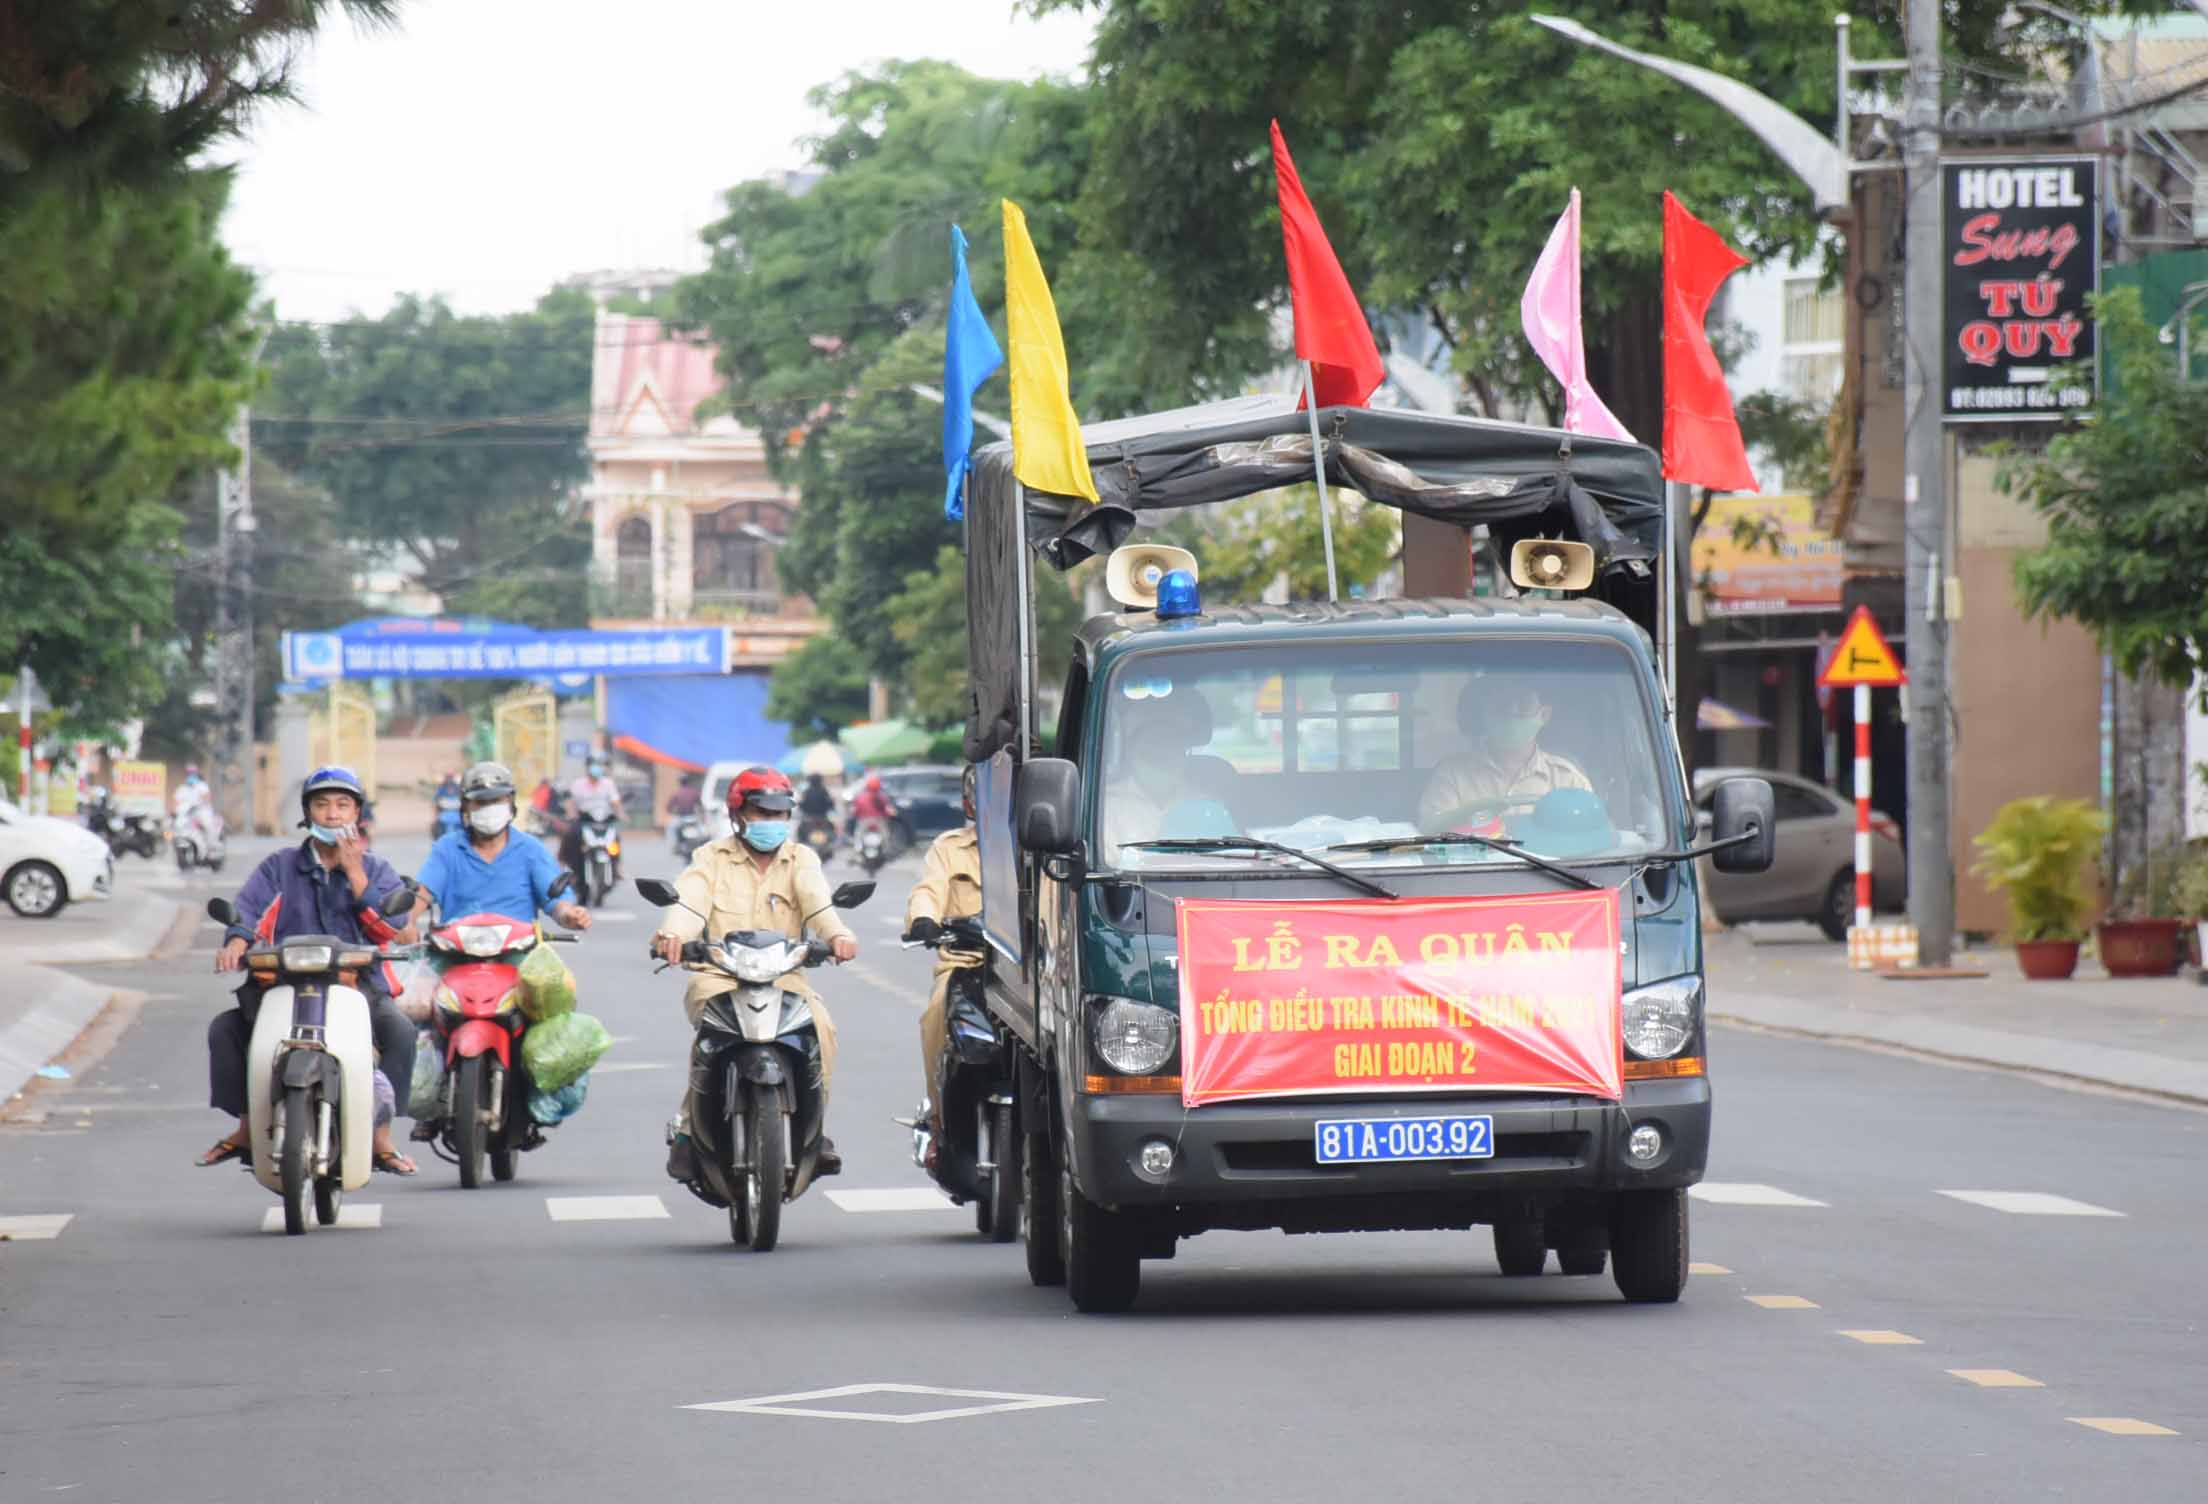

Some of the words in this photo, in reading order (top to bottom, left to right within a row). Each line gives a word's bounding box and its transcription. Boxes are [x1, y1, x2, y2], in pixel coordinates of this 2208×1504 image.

[1958, 167, 2084, 208] HOTEL
[1953, 212, 2079, 270] Sung
[1979, 271, 2063, 317] TỨ
[1959, 312, 2082, 366] QUÝ
[1232, 920, 1302, 972] LỄ
[1323, 936, 1403, 968] RA
[1420, 923, 1574, 976] QUÂN
[1200, 988, 1263, 1035] TỔNG
[1269, 987, 1323, 1031] ĐIỀU
[1330, 997, 1374, 1030] TRA
[1381, 994, 1440, 1029] KINH
[1335, 1043, 1381, 1077] GIAI
[1388, 1042, 1454, 1082] ĐOẠN
[1461, 1042, 1476, 1075] 2
[1322, 1120, 1486, 1159] 81A-003.92
